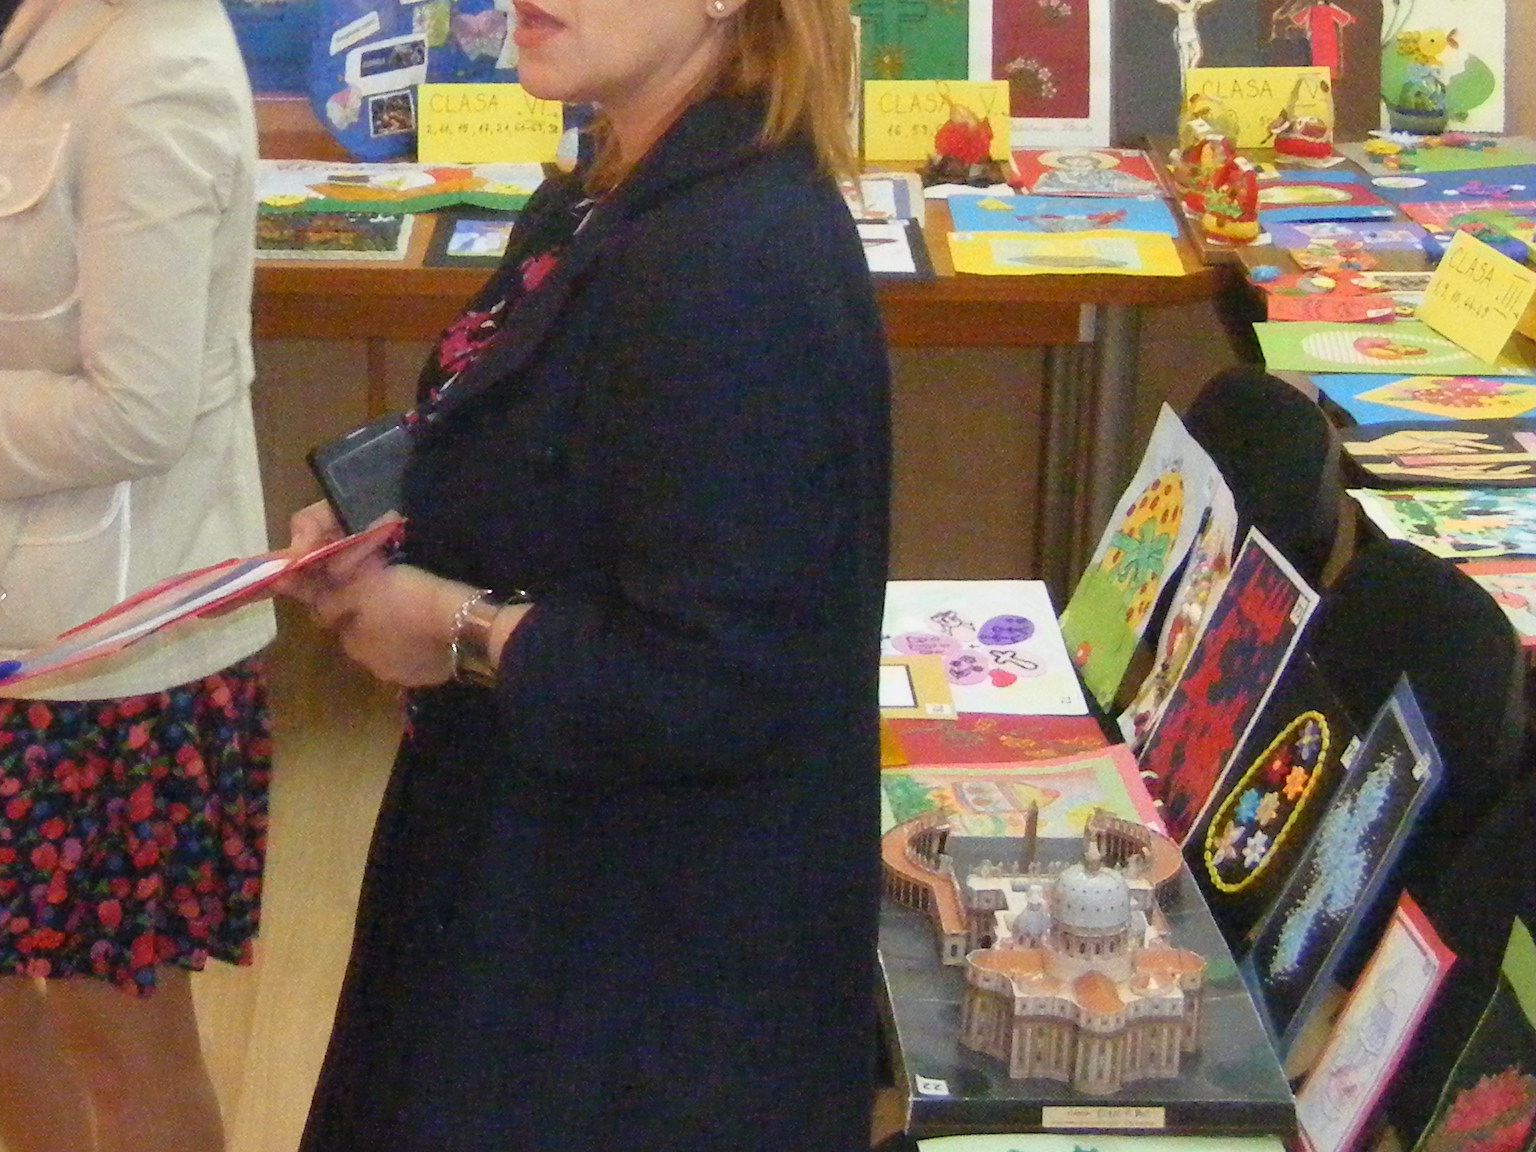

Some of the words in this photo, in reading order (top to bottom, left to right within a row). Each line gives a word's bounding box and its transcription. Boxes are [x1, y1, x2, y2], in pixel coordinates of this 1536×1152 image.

[1202, 79, 1273, 99] CLASA
[430, 92, 500, 114] CLASA
[1449, 247, 1496, 289] CLASA
